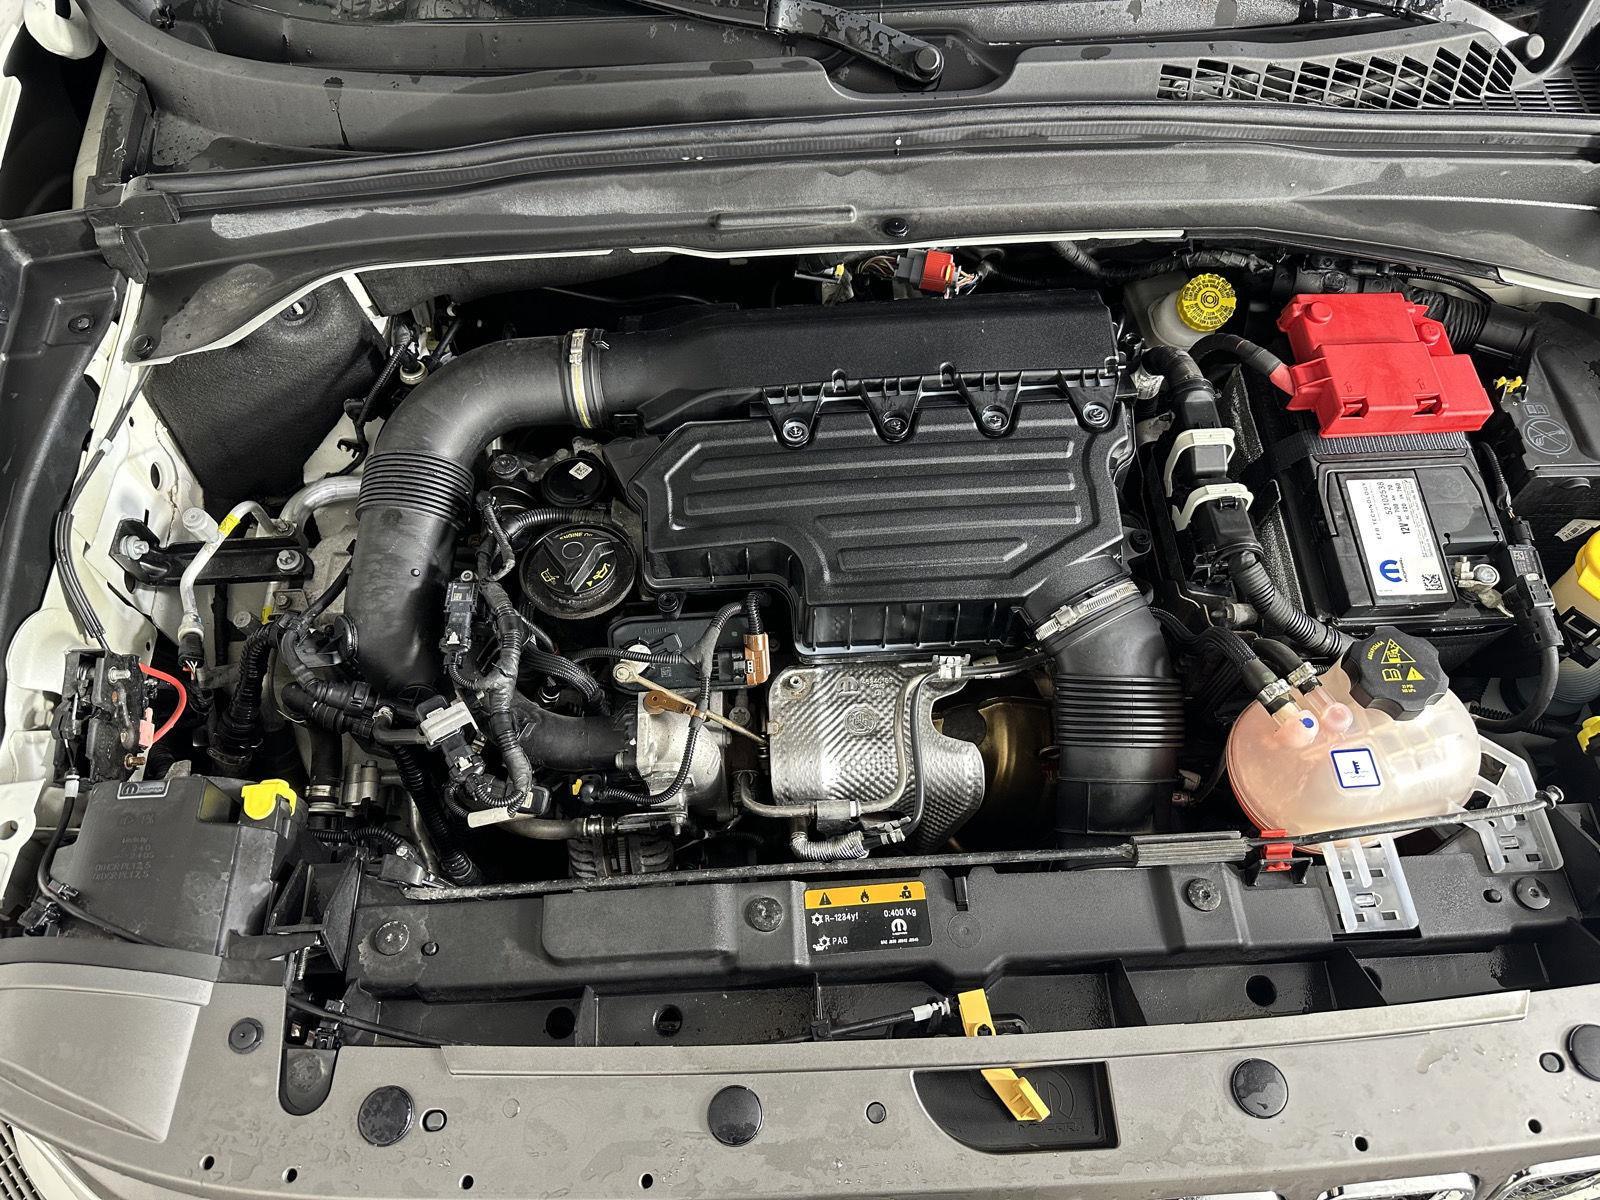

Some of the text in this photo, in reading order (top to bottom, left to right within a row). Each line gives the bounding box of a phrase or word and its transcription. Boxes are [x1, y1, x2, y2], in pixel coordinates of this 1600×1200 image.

[1362, 483, 1377, 525] TECHNOLOGY
[1399, 522, 1410, 534] 12V
[905, 907, 917, 917] Kg
[832, 936, 848, 944] PAG
